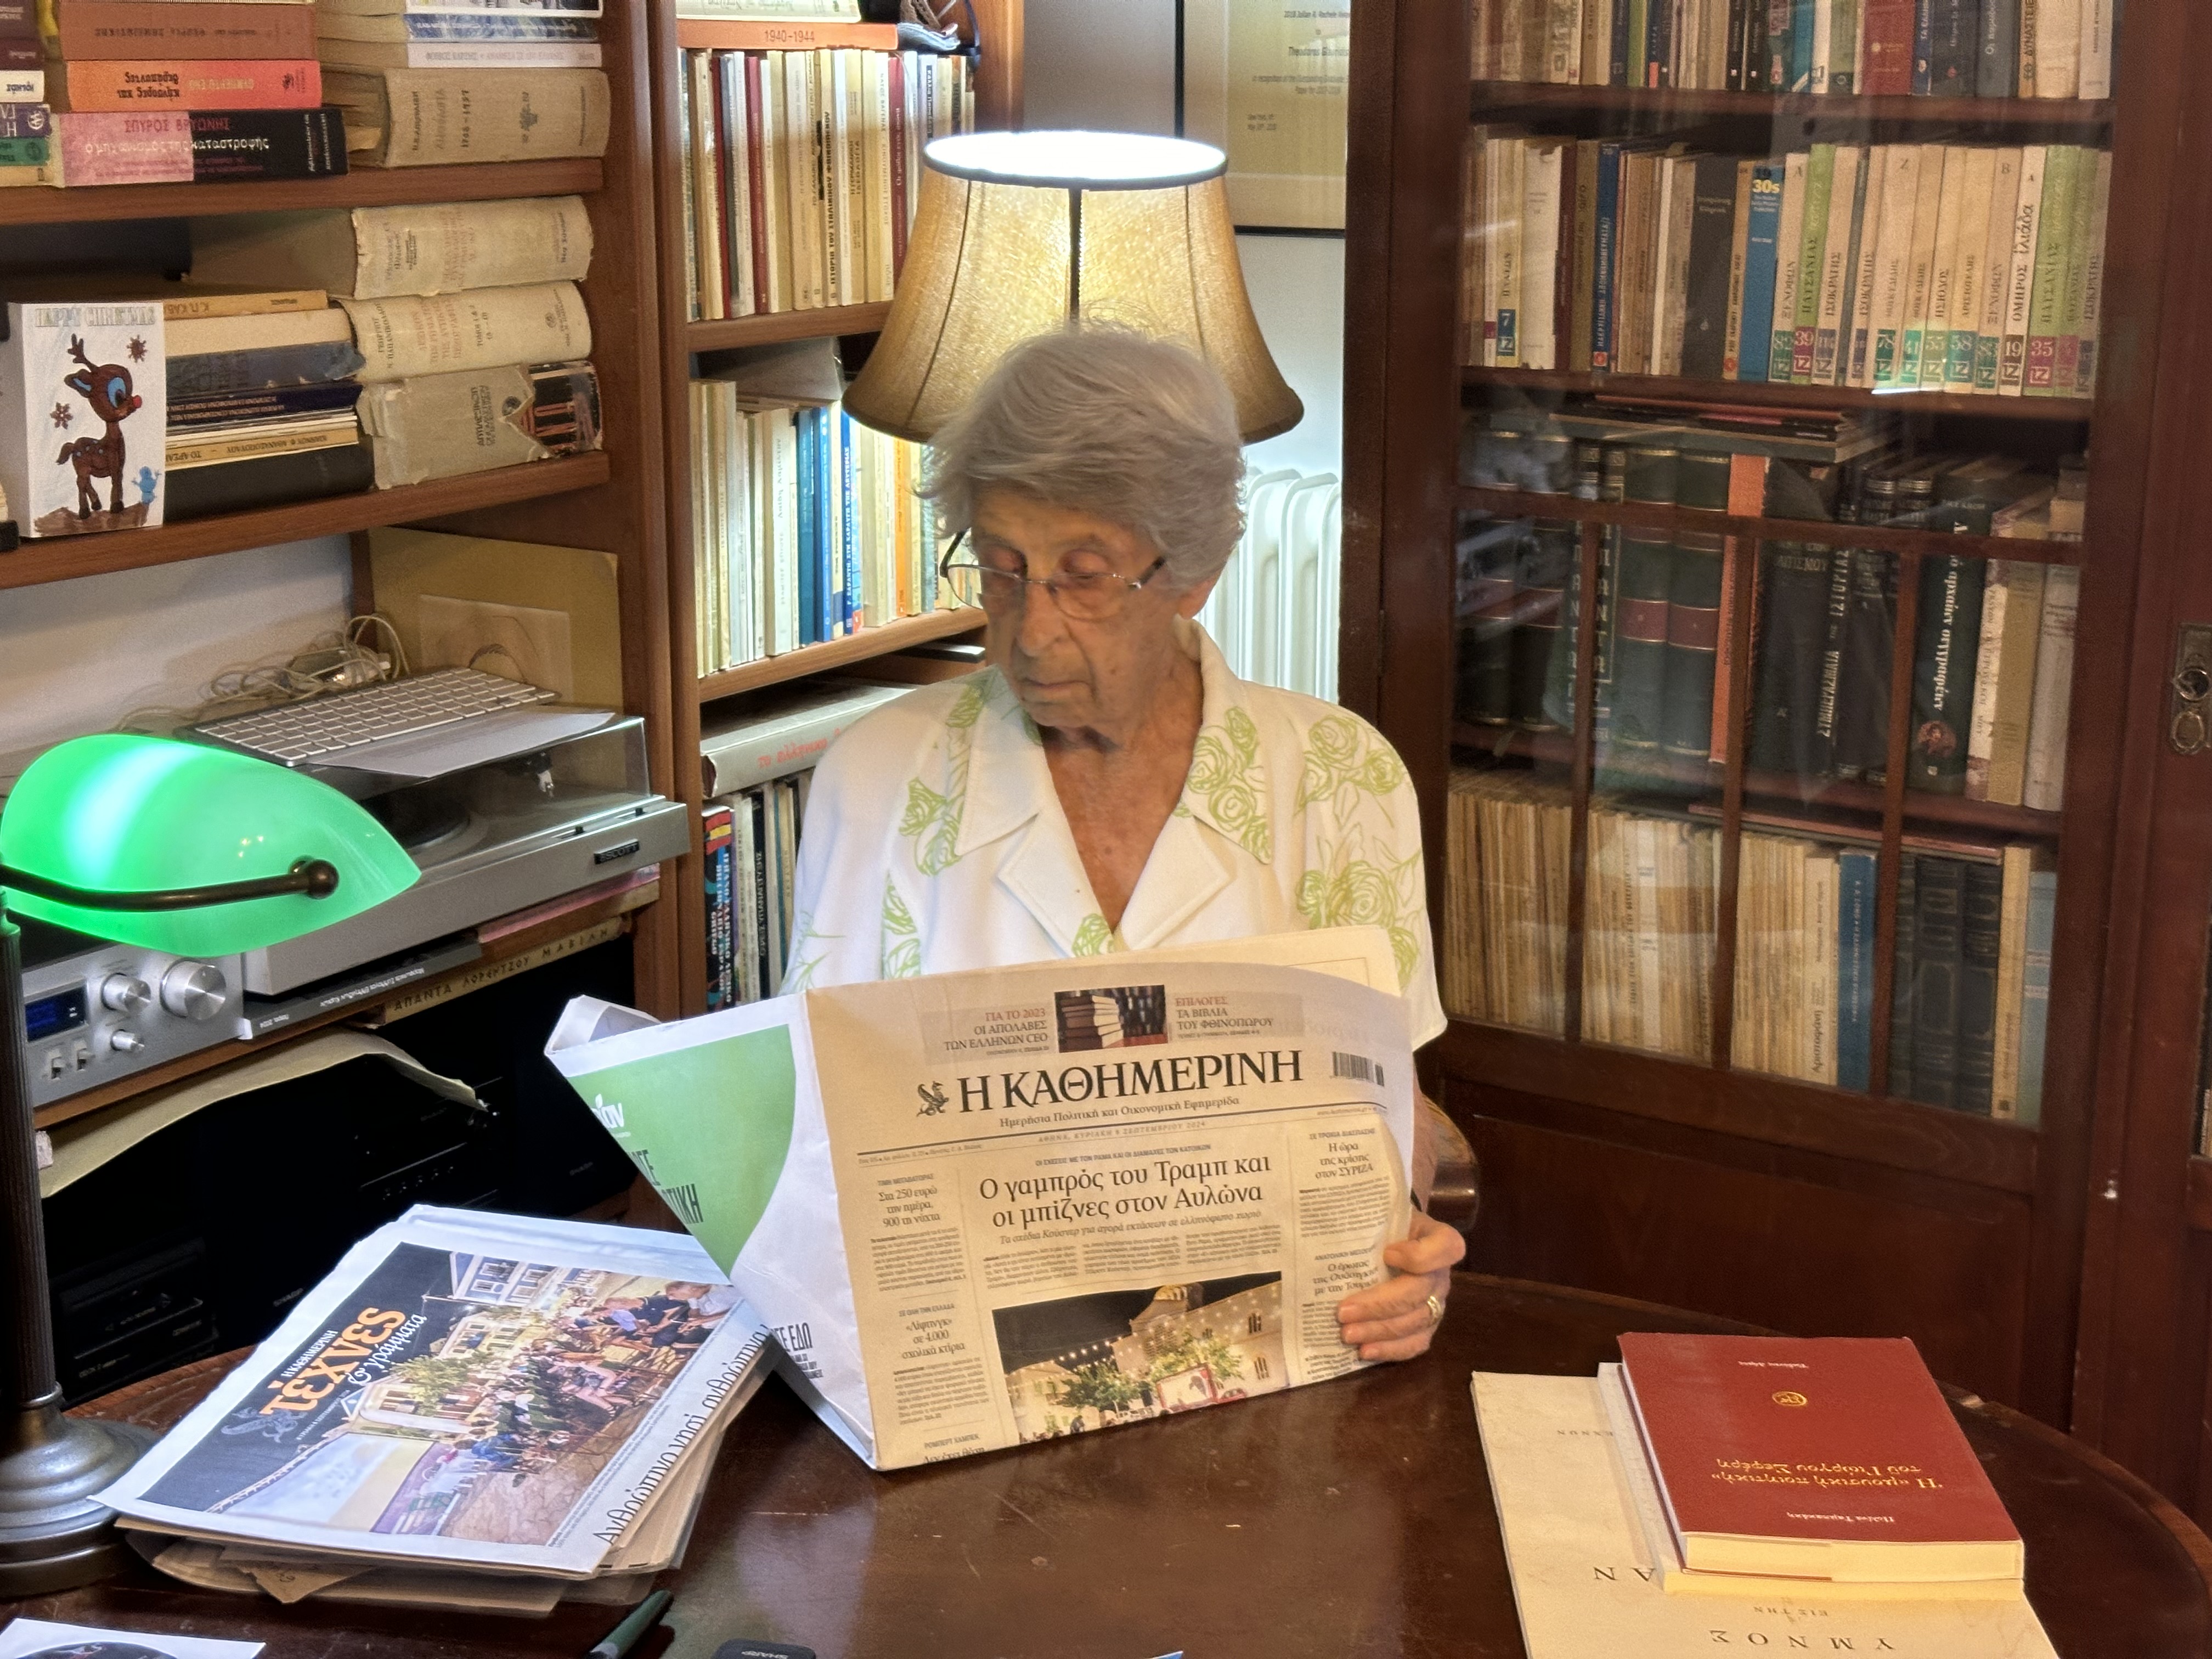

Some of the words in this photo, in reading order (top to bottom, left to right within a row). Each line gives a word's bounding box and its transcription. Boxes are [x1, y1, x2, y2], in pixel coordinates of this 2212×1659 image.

[765, 30, 815, 43] 1940-1944
[1802, 236, 1818, 313] ΠΑΥΣΑΝΙΑΣ
[2012, 264, 2027, 321] ΟΜΗΡΟΣ
[35, 306, 82, 328] HAPPY
[85, 305, 156, 326] CHRISTMAS
[1795, 330, 1814, 346] 39
[2006, 341, 2022, 357] 19
[2031, 340, 2052, 357] 35
[393, 983, 453, 1011] ΑΠΑΝΤΑ
[462, 956, 531, 989] ΛΟΡΕΝΤΖΟΥ
[541, 928, 611, 960] ΜΑΒΙΛΗ
[1176, 996, 1229, 1007] ΕΠΙΛΟΓΕΣ
[985, 1011, 1003, 1022] ΓΙΑ
[1006, 1010, 1020, 1020] ΤΟ
[1024, 1008, 1046, 1019] 2023
[1177, 1009, 1191, 1018] ΤΑ
[1192, 1007, 1229, 1018] ΒΙΒΛΙΑ
[975, 1025, 987, 1035] ΟΙ
[988, 1020, 1047, 1034] ΑΠΟΛΑΒΕΣ
[1178, 1019, 1198, 1030] ΤΟΥ
[1200, 1018, 1273, 1029] ΦΘΙΝΟΠΩΡΟΥ
[945, 1041, 968, 1051] ΤΩΝ
[969, 1035, 1025, 1049] ΕΛΛΗΝΩΝ
[958, 1075, 994, 1113] Η
[1001, 1049, 1304, 1109] ΚΑΘΗΜΕΡΙΝΗ
[1000, 1114, 1052, 1130] Ημερήσια
[1053, 1109, 1099, 1125] Πολιτική
[1102, 1108, 1119, 1119] και
[1121, 1099, 1182, 1117] Οικονομική
[1184, 1096, 1240, 1112] Εφημερίδα
[1328, 1143, 1338, 1153] Η
[1339, 1143, 1359, 1153] ώρα
[1319, 1158, 1337, 1167] της
[1338, 1153, 1369, 1166] κρίσης
[979, 1178, 999, 1199] Ο
[1004, 1169, 1104, 1200] γαμπρός
[1109, 1166, 1148, 1186] του
[1154, 1160, 1228, 1188] Τραμπ
[1234, 1156, 1272, 1175] και
[1315, 1171, 1336, 1180] στον
[1339, 1163, 1374, 1176] ΣΥΡΙΖΑ
[878, 1190, 895, 1202] Στα
[896, 1188, 912, 1200] 250
[913, 1186, 938, 1199] ευρώ
[886, 1205, 901, 1215] την
[992, 1209, 1014, 1228] οι
[1019, 1196, 1109, 1230] μπίζνες
[1115, 1193, 1168, 1215] στον
[1174, 1183, 1263, 1210] Αυλώνα
[883, 1217, 900, 1228] 900
[902, 1217, 912, 1226] τη
[913, 1212, 940, 1226] νύχτα
[913, 1335, 924, 1344] σε
[287, 1329, 338, 1375] ΚΑΘΗΜΕΡΙΝΗ
[366, 1313, 428, 1383] γράμματα
[901, 1346, 937, 1360] σχολικά
[938, 1342, 966, 1355] κτίρια
[1716, 1458, 1788, 1474] Σεφέρη
[591, 1466, 669, 1545] Ανθρώπινο
[1709, 1629, 1895, 1651] ΥΜΝΟΣ
